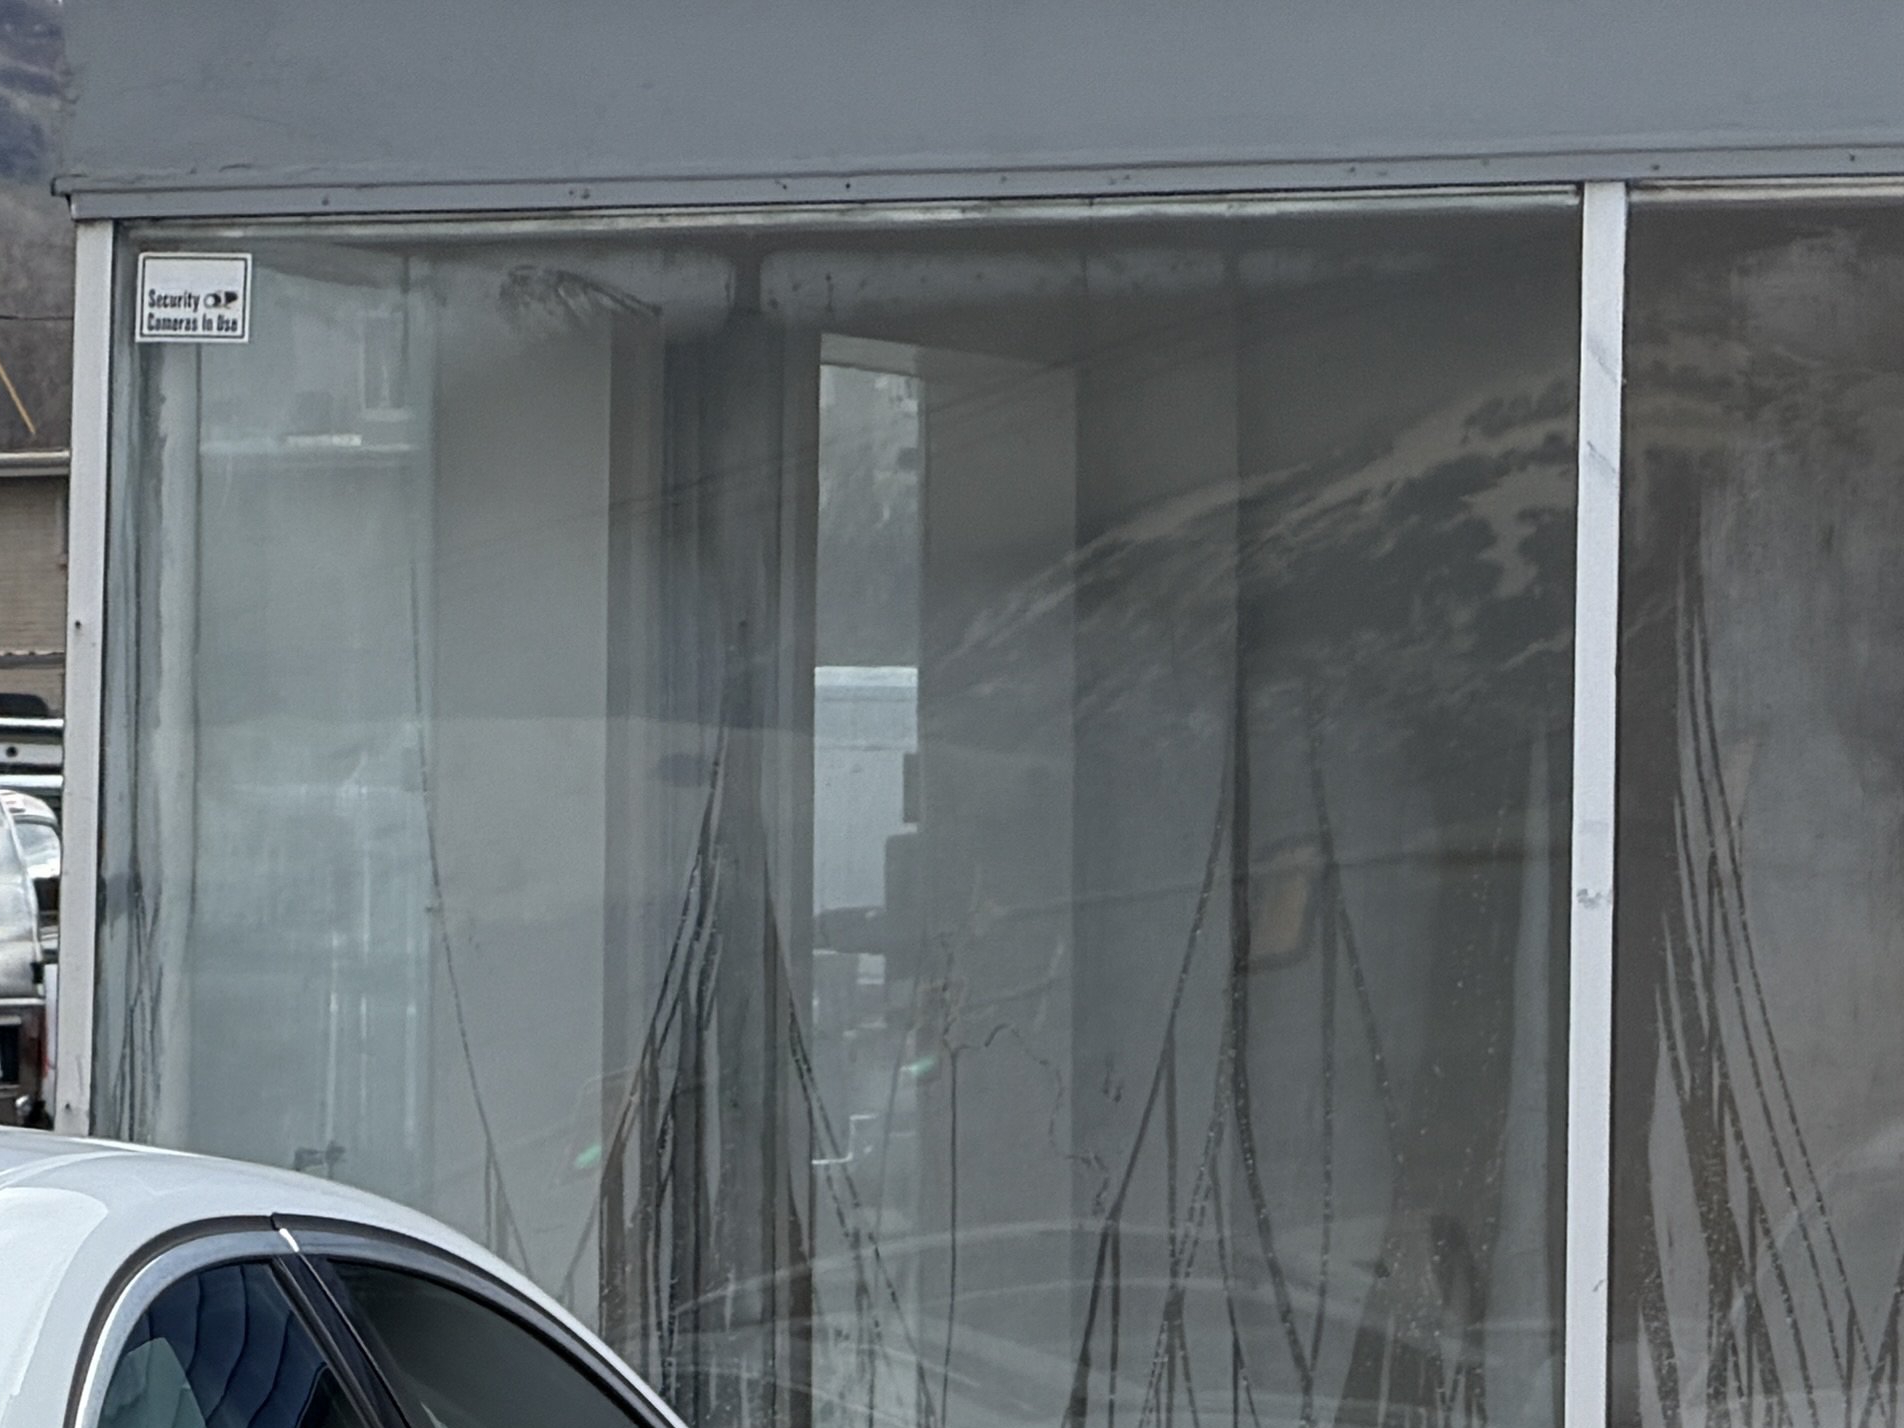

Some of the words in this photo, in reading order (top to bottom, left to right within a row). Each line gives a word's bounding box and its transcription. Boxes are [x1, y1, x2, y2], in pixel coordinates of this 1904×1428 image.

[148, 288, 200, 313] Security
[147, 313, 198, 332] Cameras
[217, 314, 238, 333] Use
